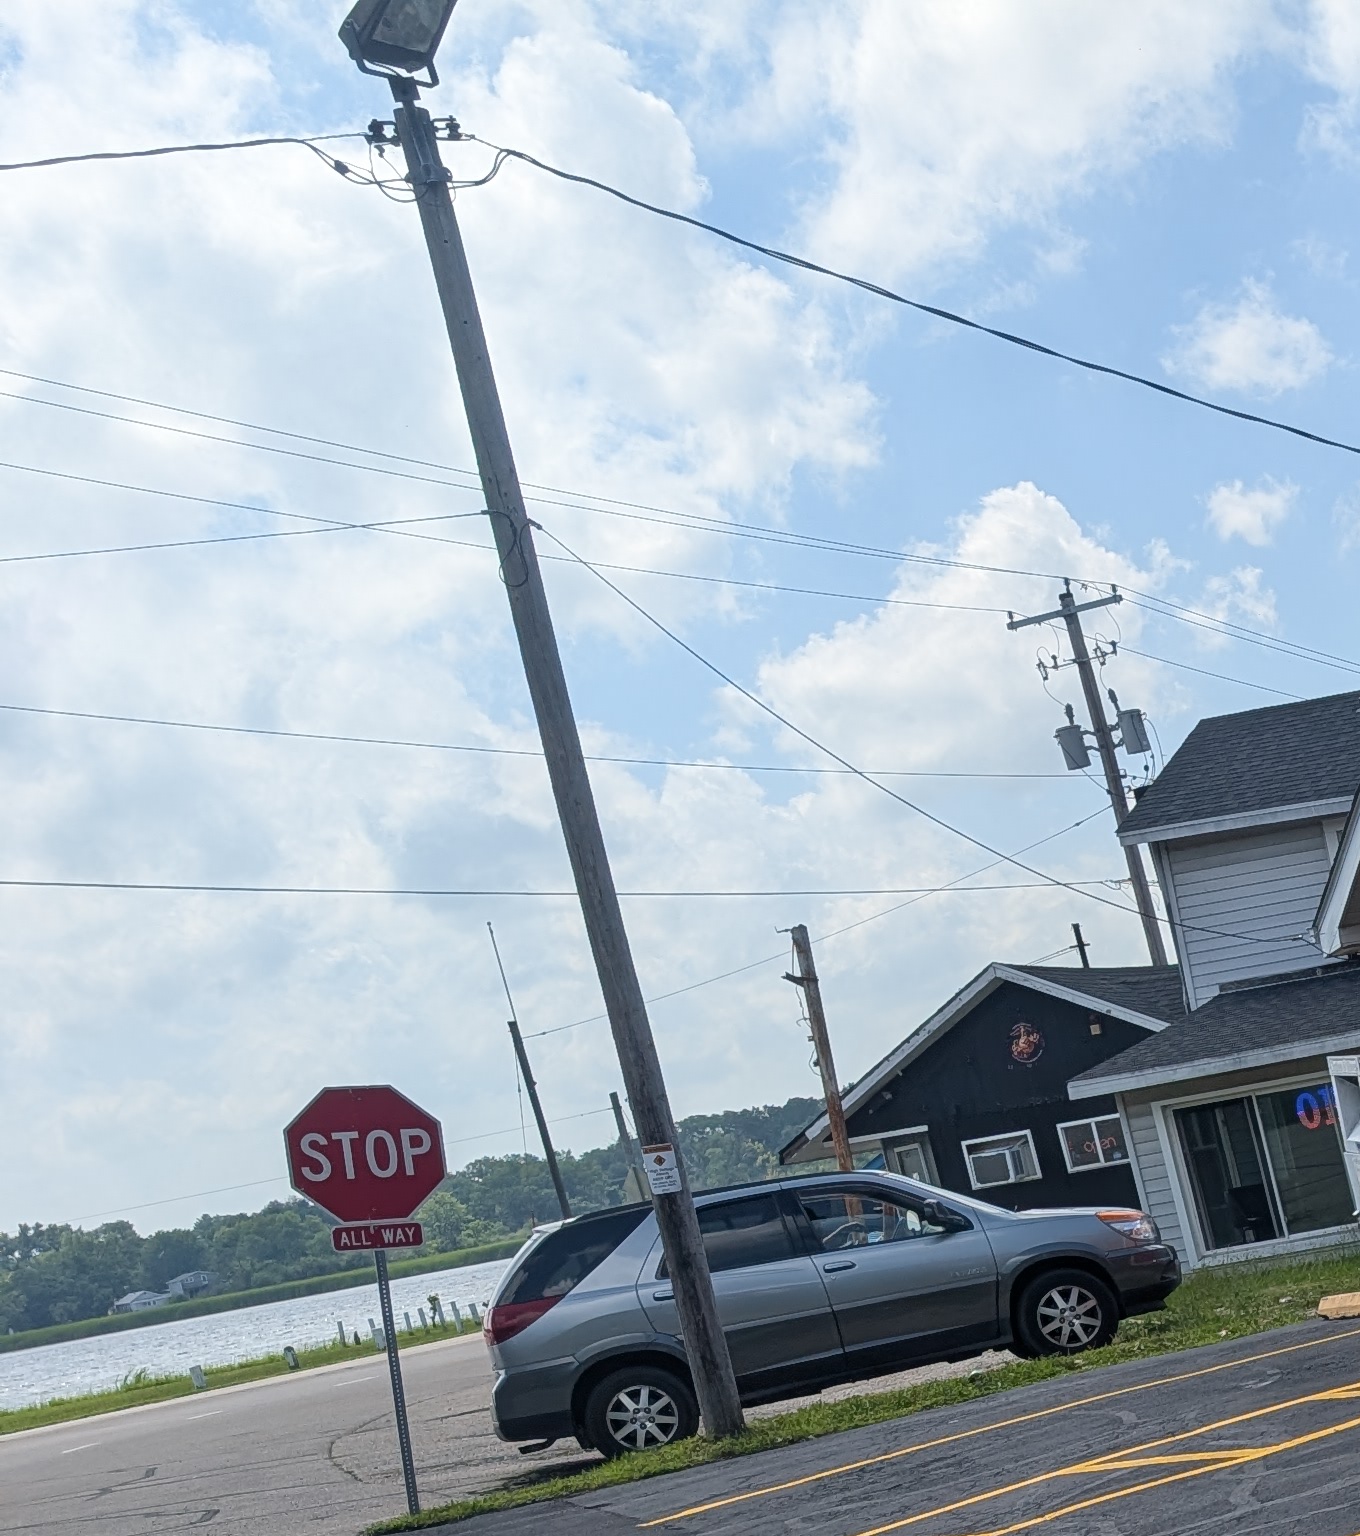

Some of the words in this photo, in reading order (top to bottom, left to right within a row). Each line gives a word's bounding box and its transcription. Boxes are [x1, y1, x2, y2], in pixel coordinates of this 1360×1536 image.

[300, 1128, 432, 1182] STOP
[340, 1230, 371, 1246] ALL
[382, 1226, 416, 1243] WAY
